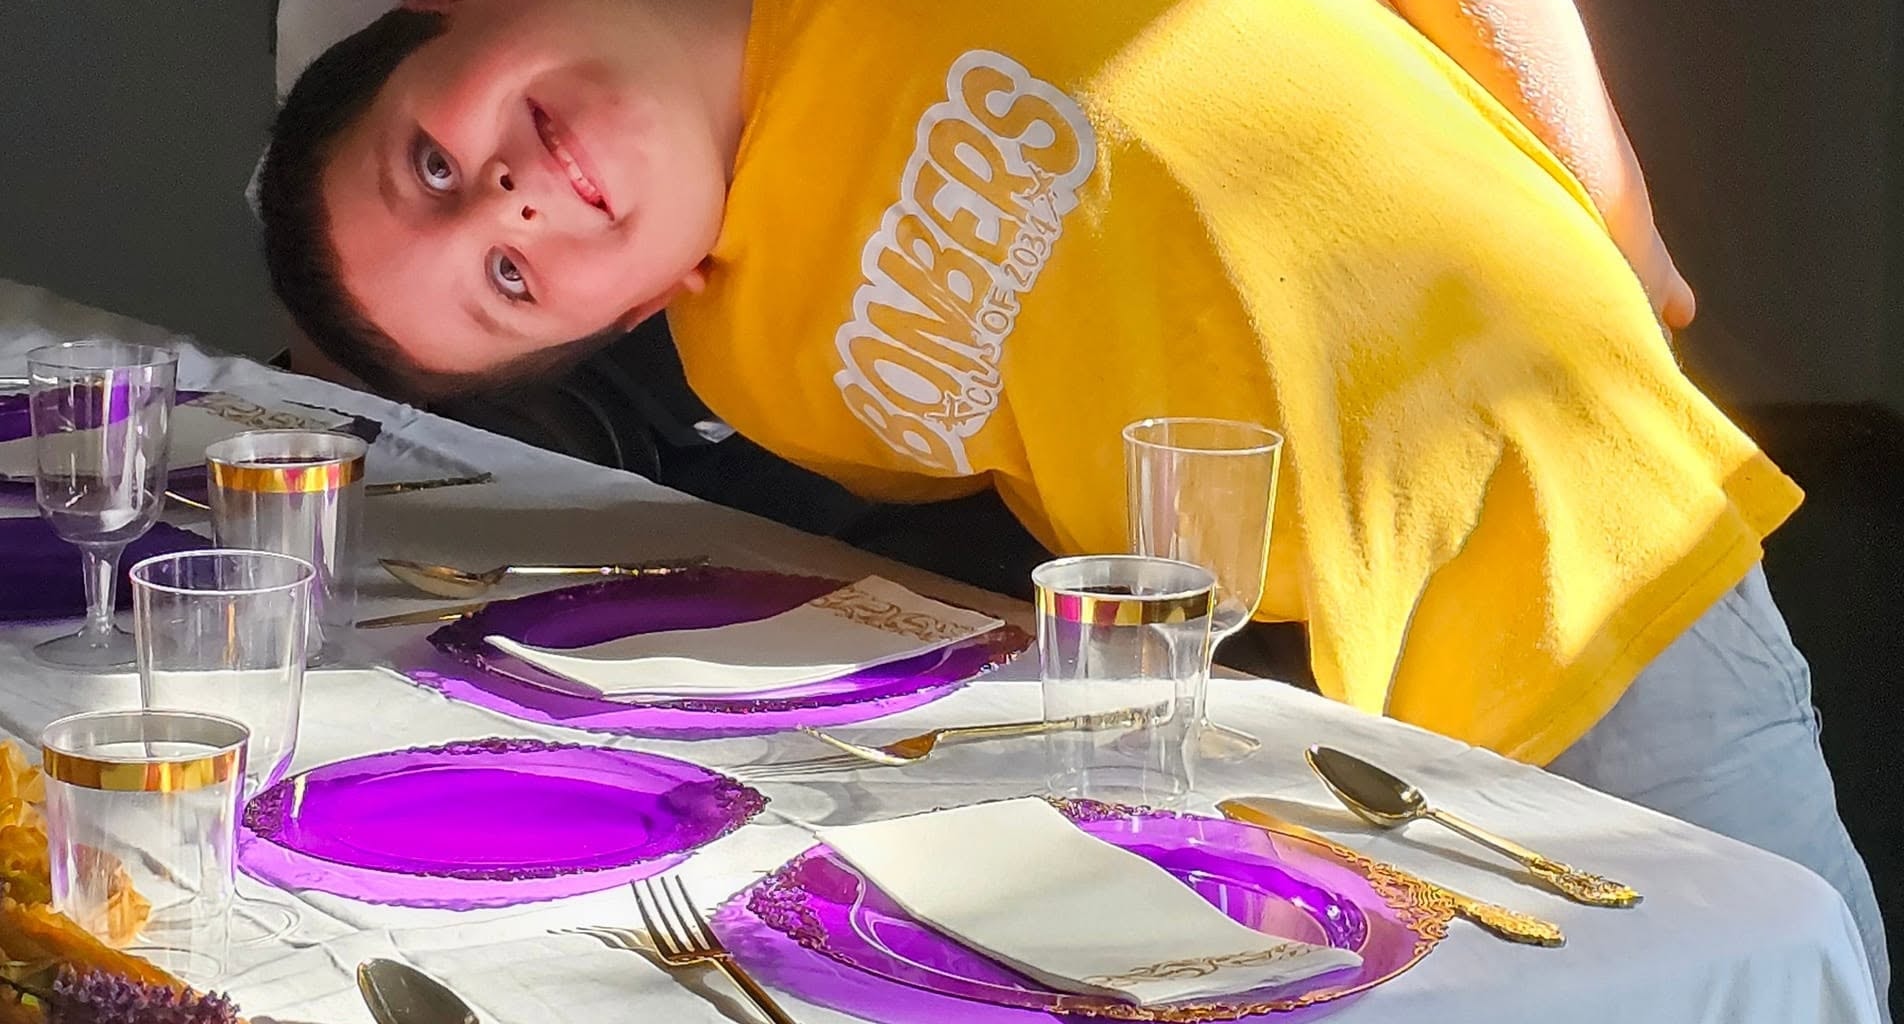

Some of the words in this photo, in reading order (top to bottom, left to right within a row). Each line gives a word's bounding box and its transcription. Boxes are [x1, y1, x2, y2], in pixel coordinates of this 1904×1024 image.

[1003, 214, 1058, 288] 2034
[980, 286, 1016, 335] OF
[964, 340, 1000, 407] CLS
